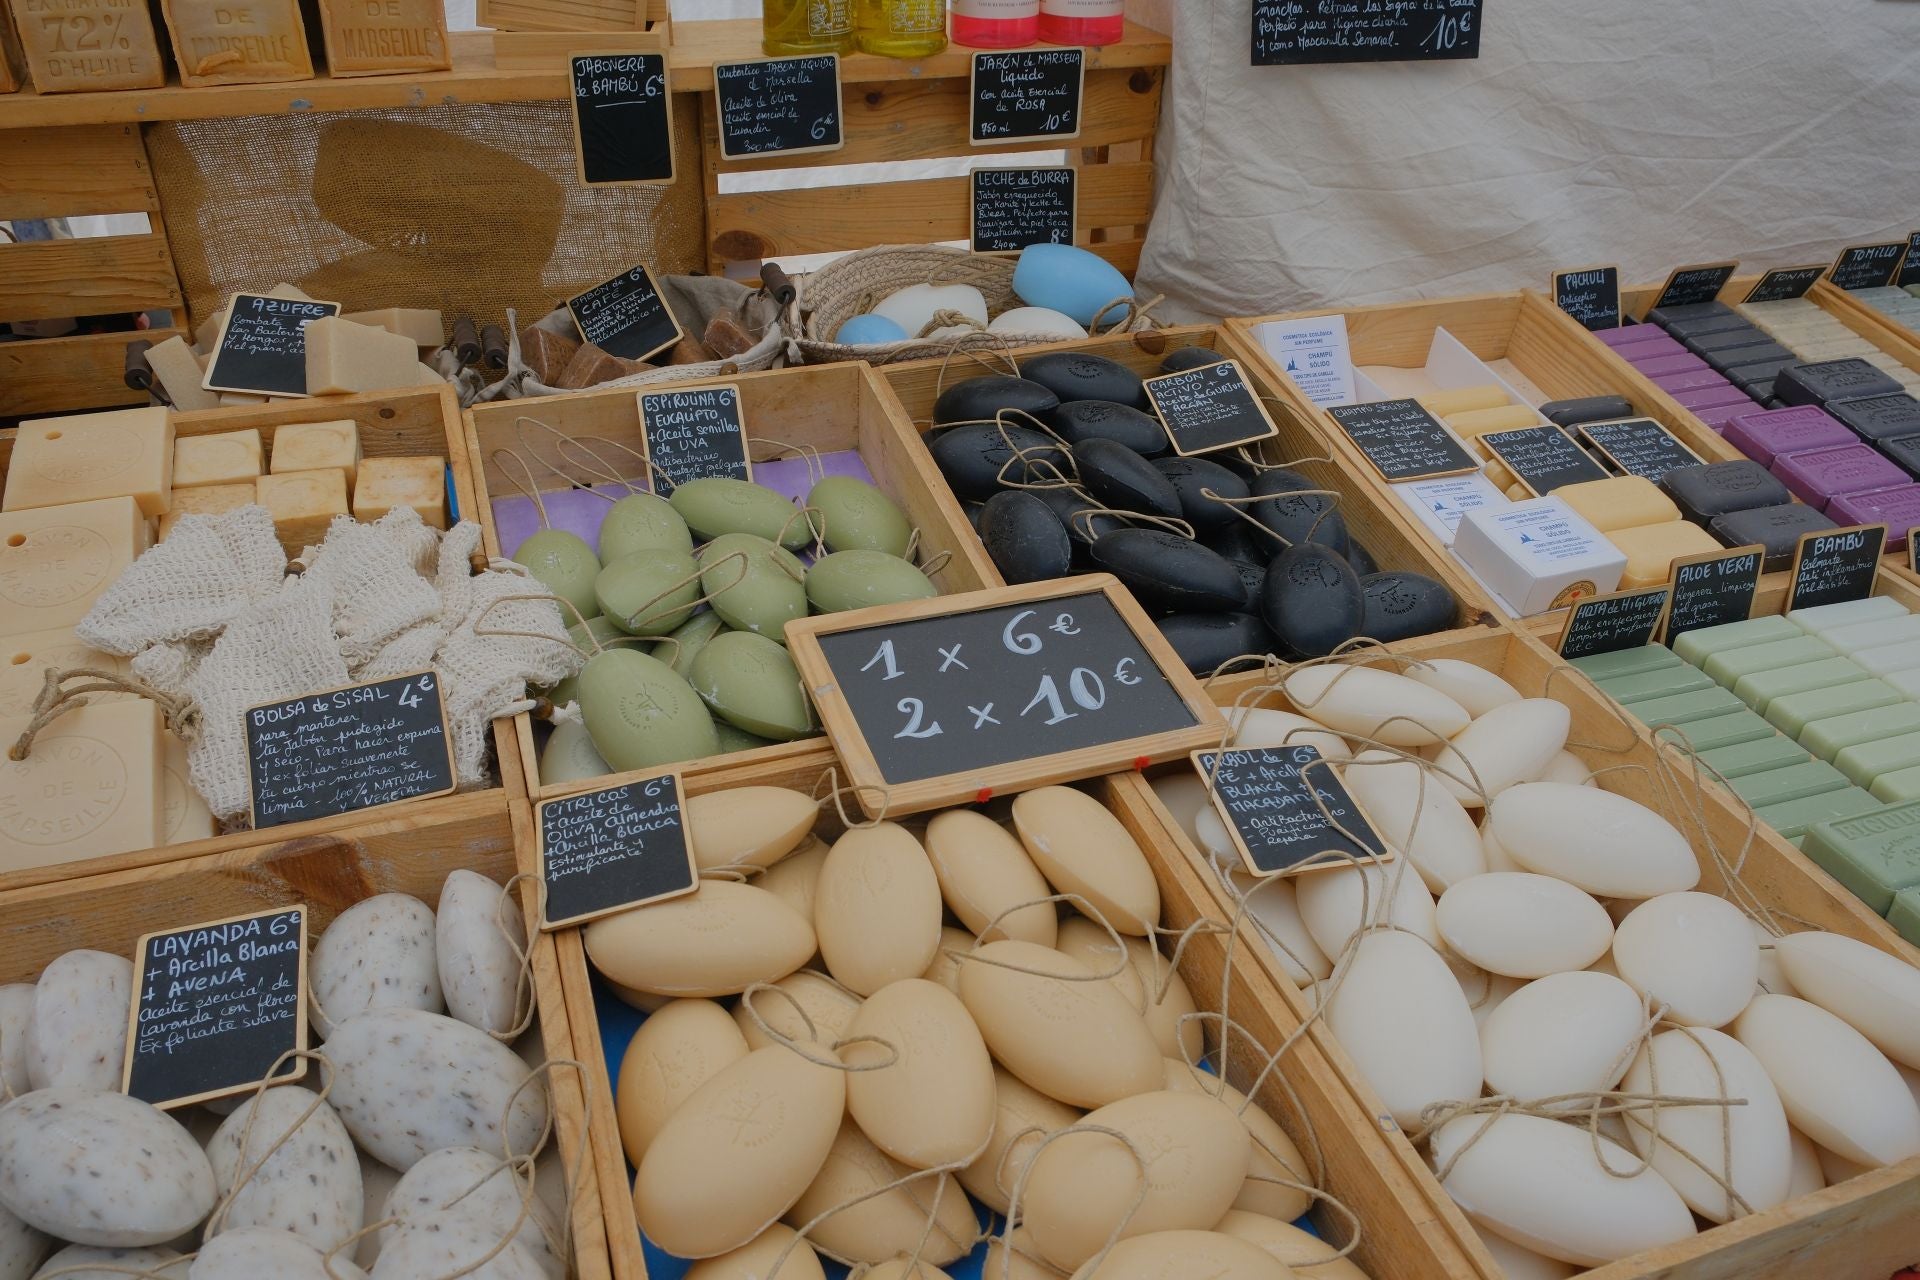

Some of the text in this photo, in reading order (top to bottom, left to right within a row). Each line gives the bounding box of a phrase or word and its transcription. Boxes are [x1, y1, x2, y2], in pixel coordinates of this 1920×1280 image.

[214, 9, 256, 25] DE
[367, 0, 401, 17] DE
[41, 14, 130, 52] 72%
[1300, 20, 1327, 34] para
[342, 28, 433, 58] MARSEILLE
[1269, 42, 1294, 51] como
[576, 56, 646, 78] JABONERA
[979, 52, 1080, 71] JABÓN de MARSELLA
[592, 73, 639, 96] BAMBÚ
[996, 98, 1046, 112] de ROSA
[979, 170, 1070, 186] LECHE de BURRA
[1048, 210, 1070, 219] para
[1853, 246, 1897, 261] TOMILLO
[1775, 271, 1816, 282] TONKA
[252, 298, 325, 315] AZUFRE
[1150, 371, 1204, 391] CARBÓN
[1157, 382, 1202, 399] ACTIVO
[645, 392, 717, 412] ESPIRULINA
[655, 408, 719, 428] EUCALIPTO
[657, 438, 709, 455] de UVA
[1814, 529, 1865, 556] BAMBÚ
[1680, 554, 1755, 583] ALOE VERA
[1577, 592, 1668, 618] HOJA de HIGUERA
[860, 639, 905, 681] 1
[253, 701, 306, 727] BOLSA
[312, 698, 329, 713] de
[333, 687, 390, 709] SISAL
[893, 697, 944, 739] 2
[255, 730, 288, 750] para
[356, 734, 394, 750] hacer
[1262, 750, 1283, 764] de
[374, 769, 437, 792] NATURAL
[1222, 781, 1291, 800] BLANCA
[363, 784, 429, 806] VEGETAL
[609, 801, 635, 815] de
[617, 817, 679, 838] Blanca
[153, 920, 261, 957] LAVANDA
[169, 948, 232, 978] Arcilla
[239, 940, 299, 962] Blanca
[271, 971, 293, 991] de
[221, 1003, 252, 1016] con
